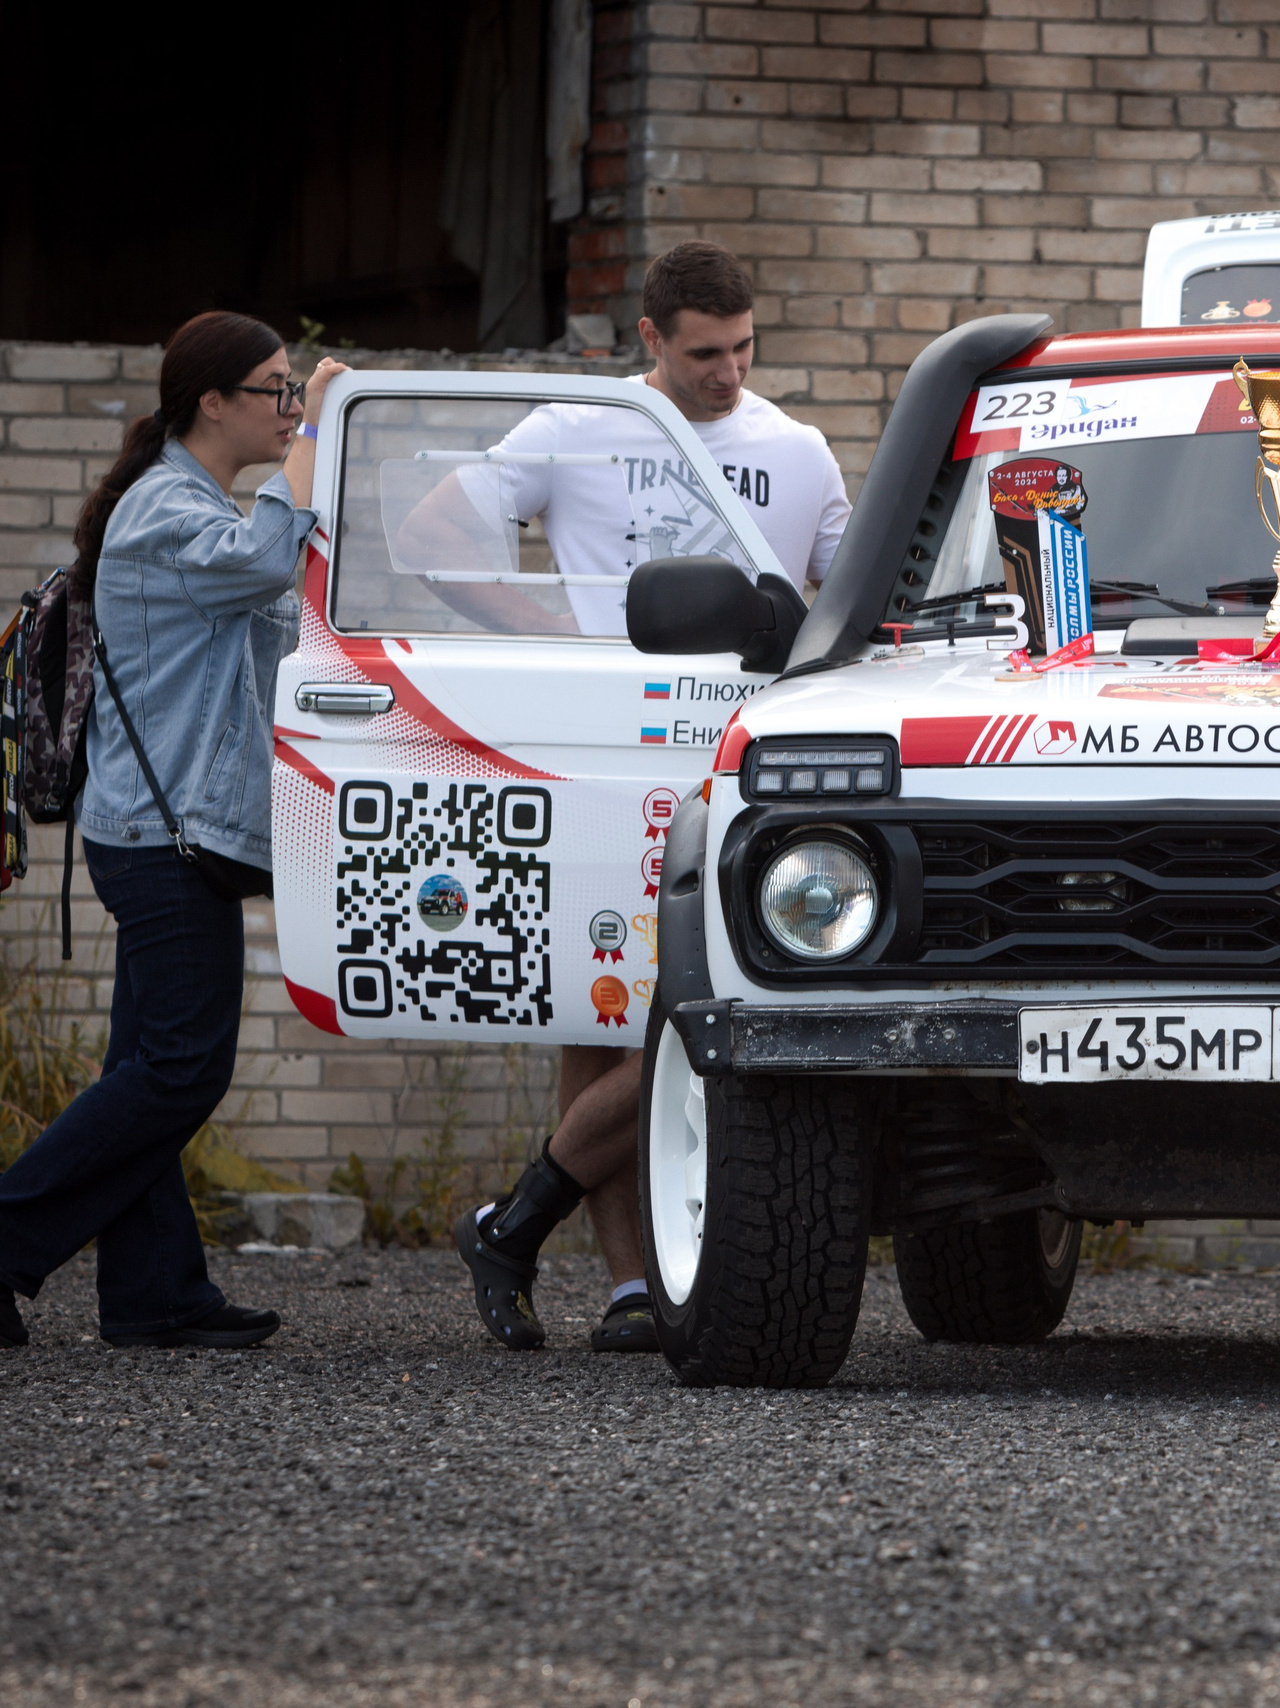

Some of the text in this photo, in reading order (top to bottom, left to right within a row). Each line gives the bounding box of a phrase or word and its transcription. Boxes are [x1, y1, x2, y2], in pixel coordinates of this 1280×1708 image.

[982, 391, 1057, 422] 223
[1014, 469, 1054, 479] АВГУСТА
[1063, 529, 1077, 588] РОССИИ
[1041, 548, 1055, 628] НАЦИОНАЛЬНЫЙ
[984, 593, 1029, 650] 3
[1081, 724, 1140, 755] МБ
[652, 800, 672, 817] 5
[598, 922, 618, 940] 2
[1040, 1016, 1263, 1074] Н435МР
